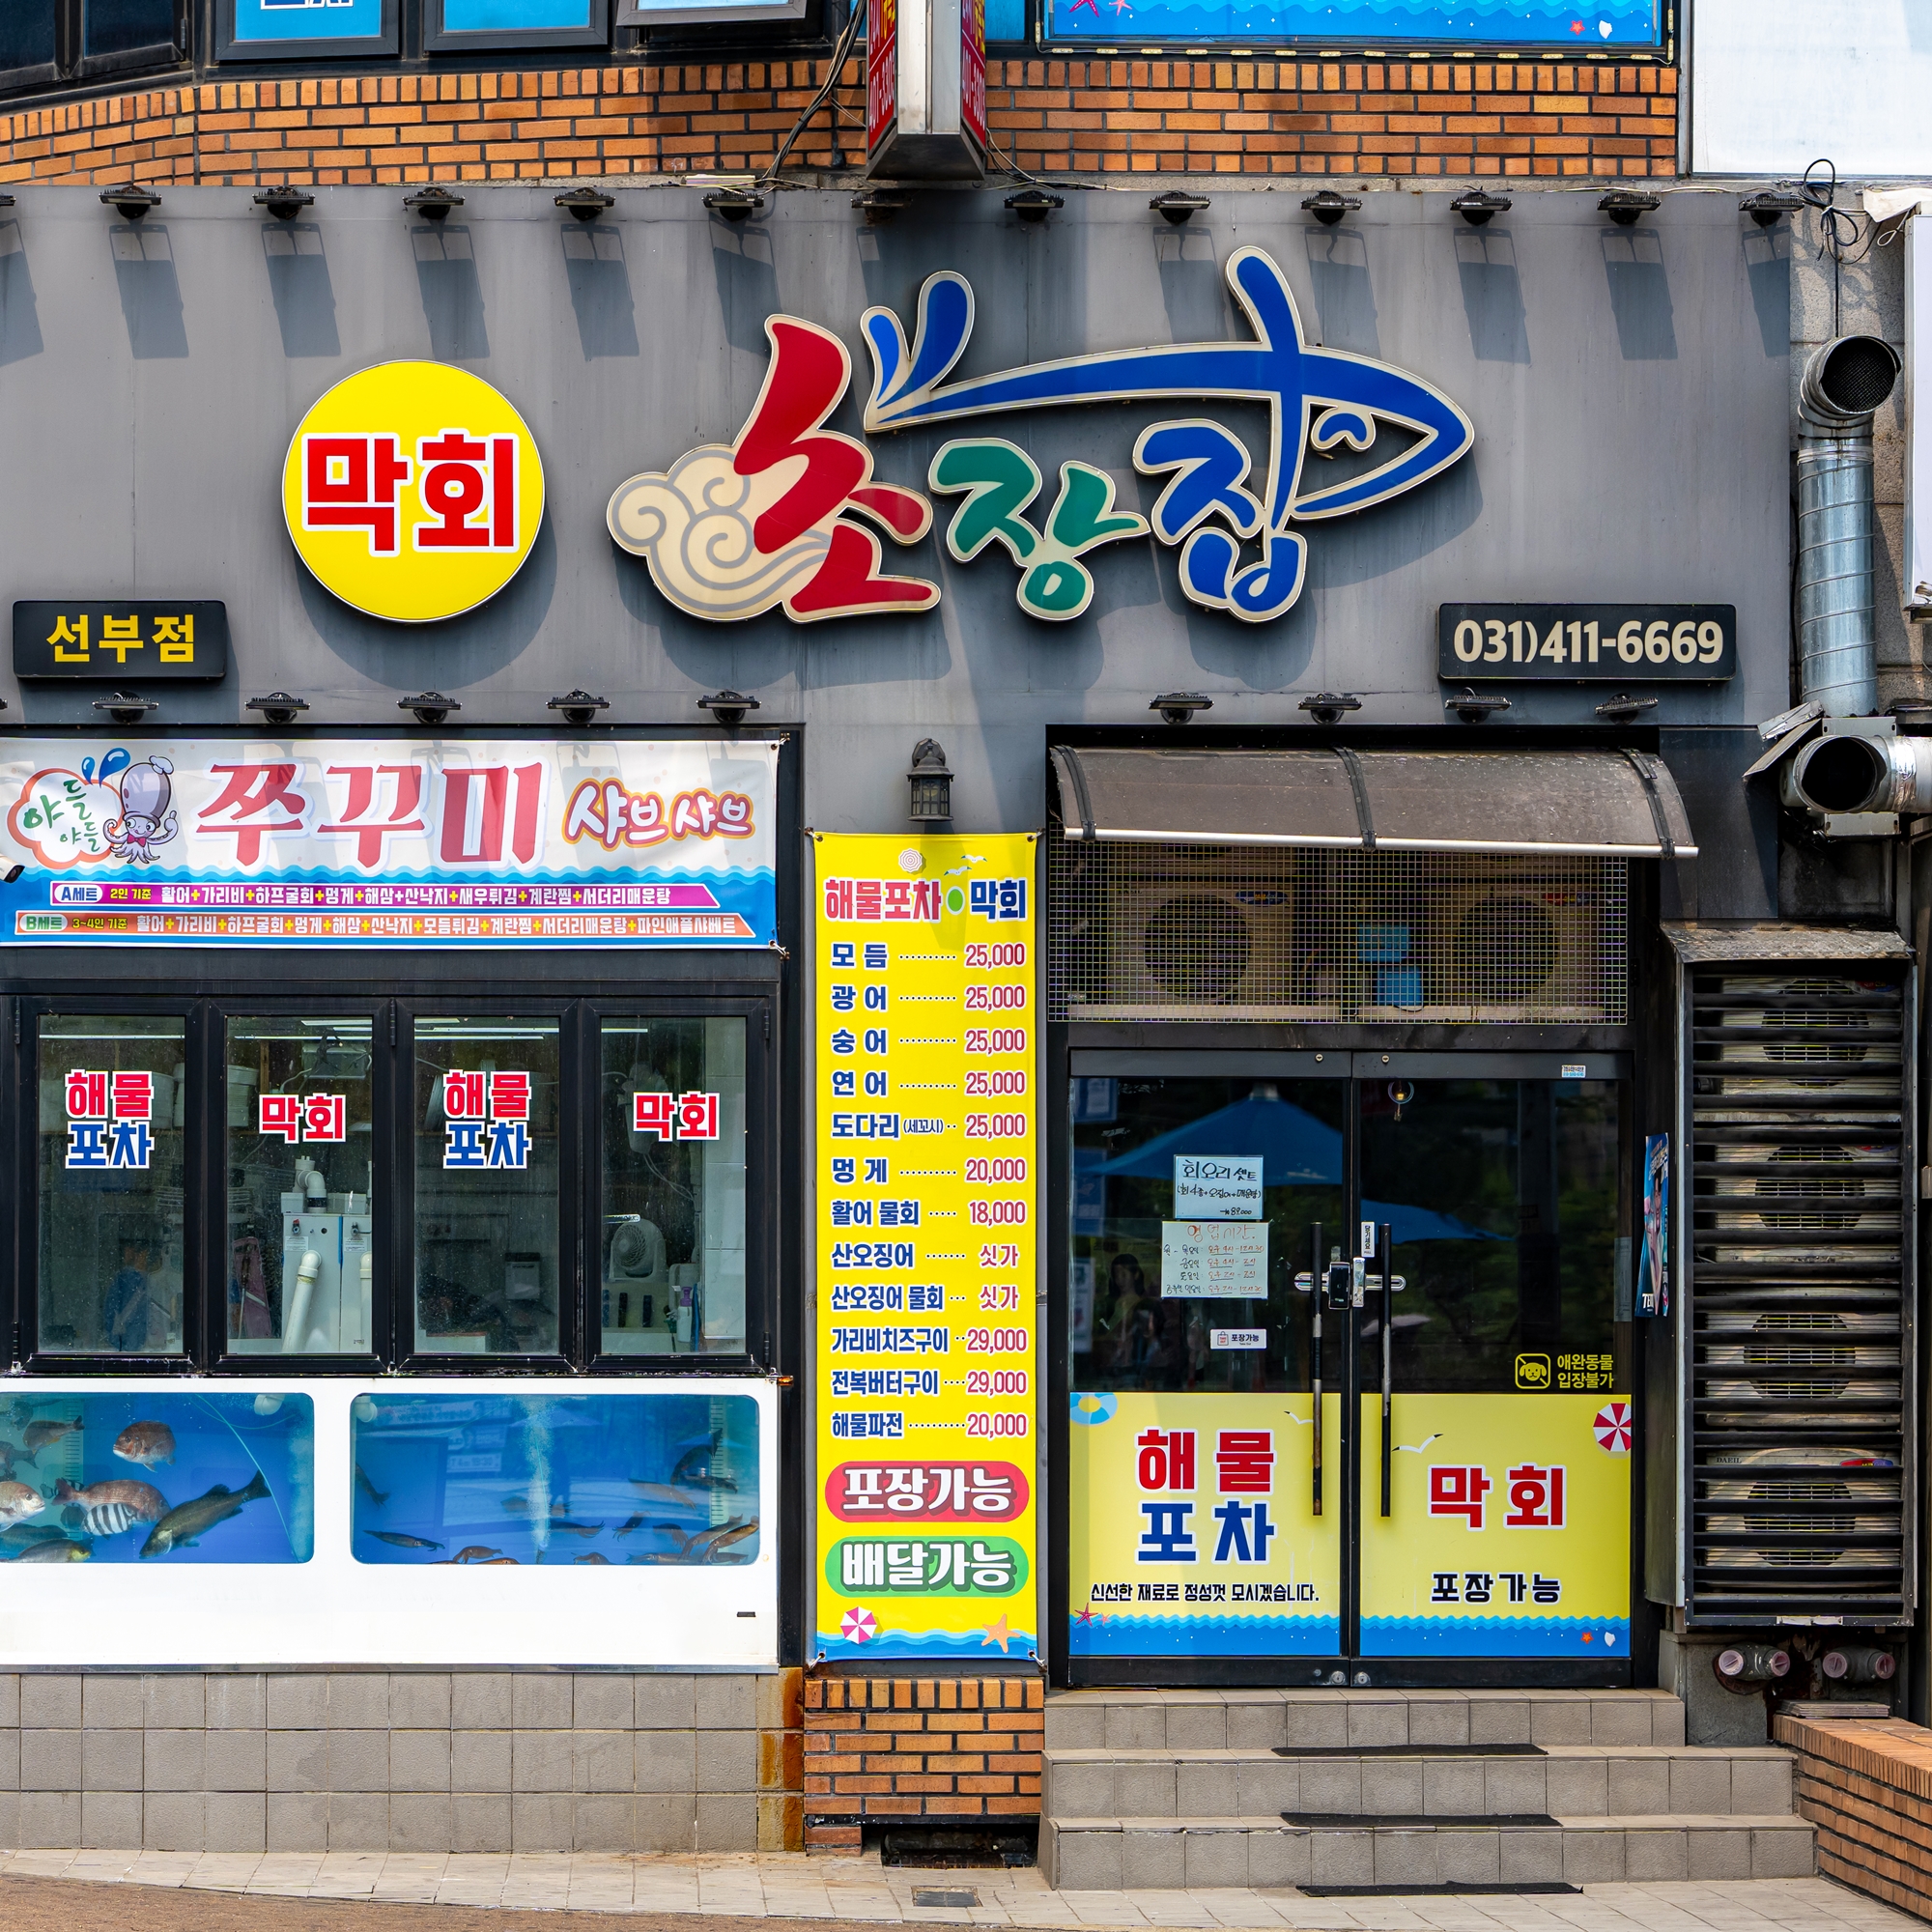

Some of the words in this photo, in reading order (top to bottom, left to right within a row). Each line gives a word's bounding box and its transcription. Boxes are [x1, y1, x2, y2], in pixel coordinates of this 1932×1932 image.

[302, 429, 519, 556] 막회
[46, 613, 195, 663] 선부점
[1453, 619, 1724, 664] 031)411-6669
[195, 761, 543, 867] 쭈꾸미
[61, 886, 98, 901] A세트
[109, 888, 128, 899] 2인
[130, 888, 152, 900] 기준
[825, 878, 942, 921] 해물포차
[970, 878, 1027, 921] 막회
[26, 916, 63, 931] B세트
[71, 918, 104, 929] 3~4인
[108, 919, 128, 929] 기준
[965, 943, 1026, 969] 25,000
[965, 985, 1026, 1011] 25,000
[965, 1029, 1026, 1055] 25,000
[65, 1069, 154, 1121] 해물
[442, 1069, 531, 1121] 해물
[965, 1071, 1026, 1097] 25,000
[259, 1093, 346, 1144] 막회
[633, 1091, 720, 1141] 막회
[832, 1114, 899, 1139] 도다리
[965, 1114, 1026, 1139] 25,000
[65, 1121, 155, 1169] 포차
[442, 1121, 531, 1169] 포차
[965, 1159, 1026, 1184] 20,000
[832, 1201, 872, 1226] 활어
[878, 1201, 920, 1226] 물회
[969, 1201, 1026, 1227] 18,000
[832, 1243, 914, 1268] 산오징어
[980, 1244, 1019, 1267] 싯가
[831, 1286, 902, 1310] 산오징어
[908, 1285, 944, 1310] 물회
[980, 1286, 1019, 1309] 싯가
[831, 1327, 949, 1352] 가리비치즈구이
[967, 1328, 1027, 1354] 29,000
[1557, 1353, 1614, 1371] 애완동물
[832, 1370, 939, 1395] 전복버터구이
[967, 1371, 1027, 1397] 29,000
[1557, 1372, 1614, 1389] 입장불가
[832, 1412, 903, 1437] 해물파전
[967, 1413, 1027, 1439] 20,000
[842, 1467, 1012, 1512] 포장가능
[842, 1543, 1012, 1587] 배달가능
[1091, 1583, 1133, 1602] 신선한
[1137, 1583, 1180, 1602] 재료로
[1184, 1583, 1227, 1602] 정성껏
[1231, 1583, 1320, 1602] 모시겠습니다.
[1431, 1573, 1561, 1604] 포장가능
